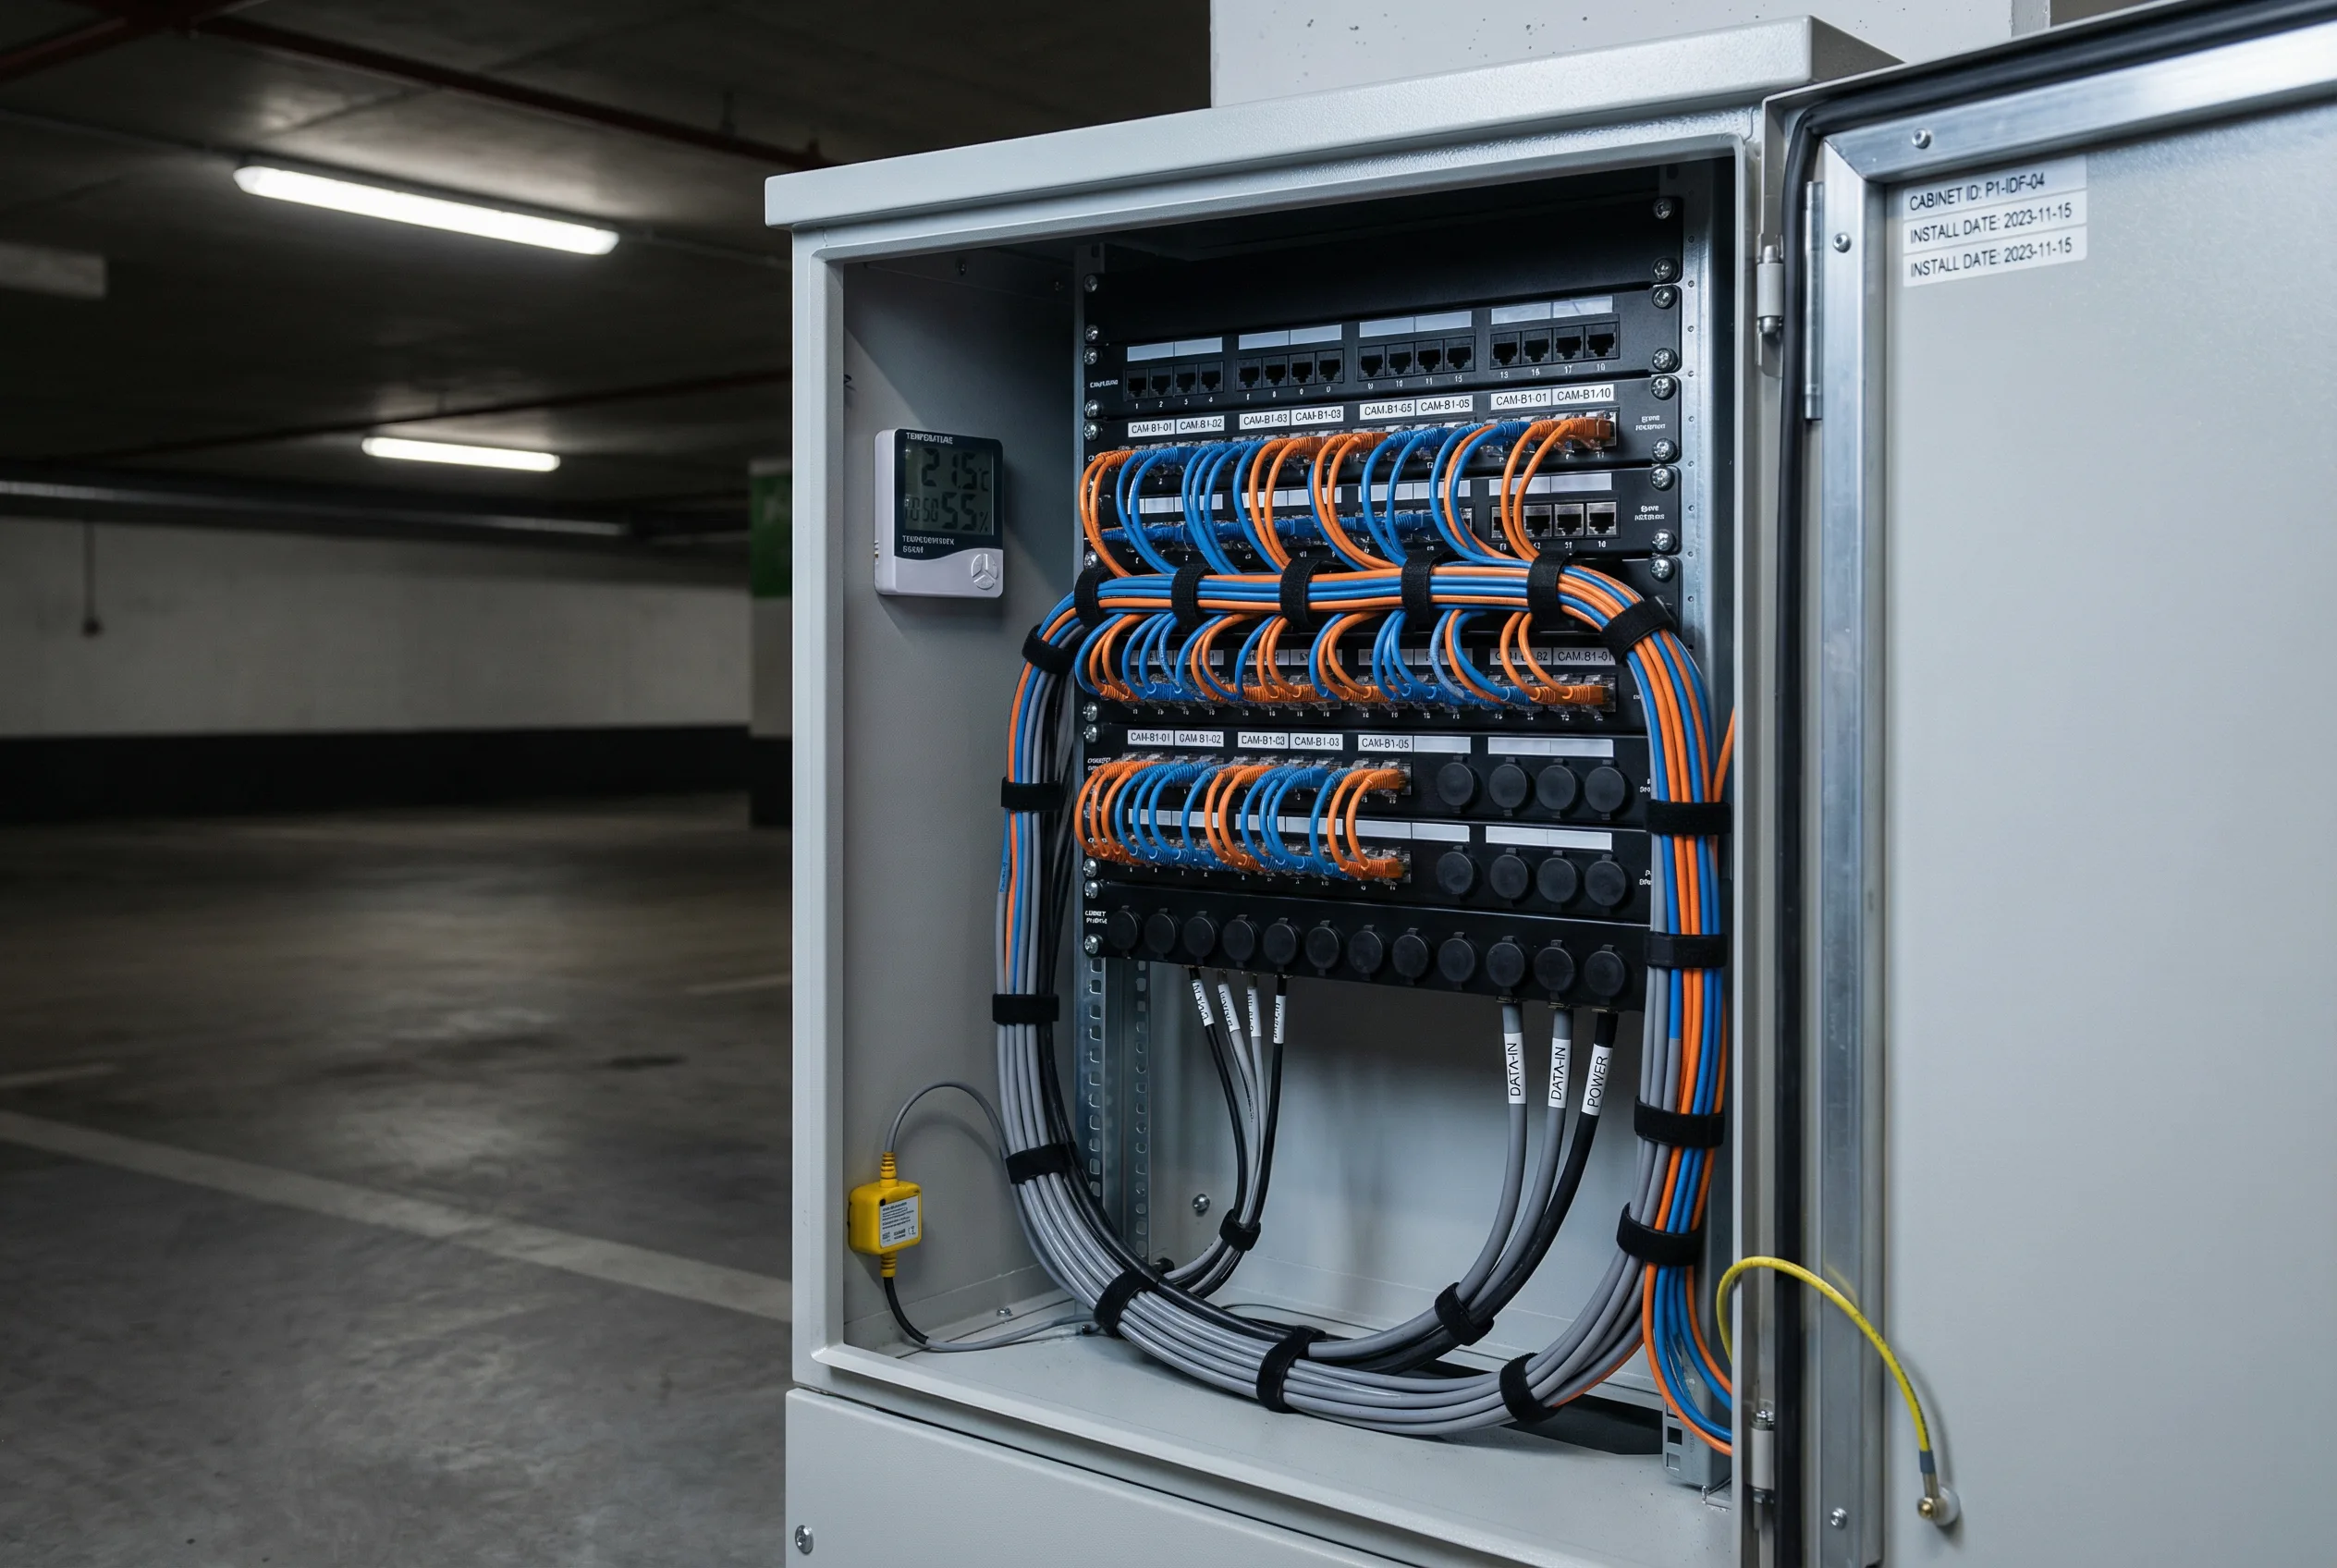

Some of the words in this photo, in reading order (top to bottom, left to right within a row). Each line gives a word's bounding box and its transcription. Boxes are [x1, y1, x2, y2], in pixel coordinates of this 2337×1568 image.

[1910, 187, 1963, 211] CABINET
[1966, 184, 1982, 202] ID:
[1986, 171, 2045, 198] P1-IDF-04
[1910, 222, 1960, 244] INSTALL
[1964, 214, 2001, 236] DATE:
[2004, 202, 2073, 229] 2023-11-15
[1910, 255, 1960, 277] INSTALL
[1964, 249, 2001, 270] DATE:
[2004, 237, 2073, 263] 2023-11-15
[1507, 1043, 1521, 1096] DATA-IN
[1551, 1047, 1566, 1100] DATA-IN
[1587, 1056, 1609, 1108] POWER
